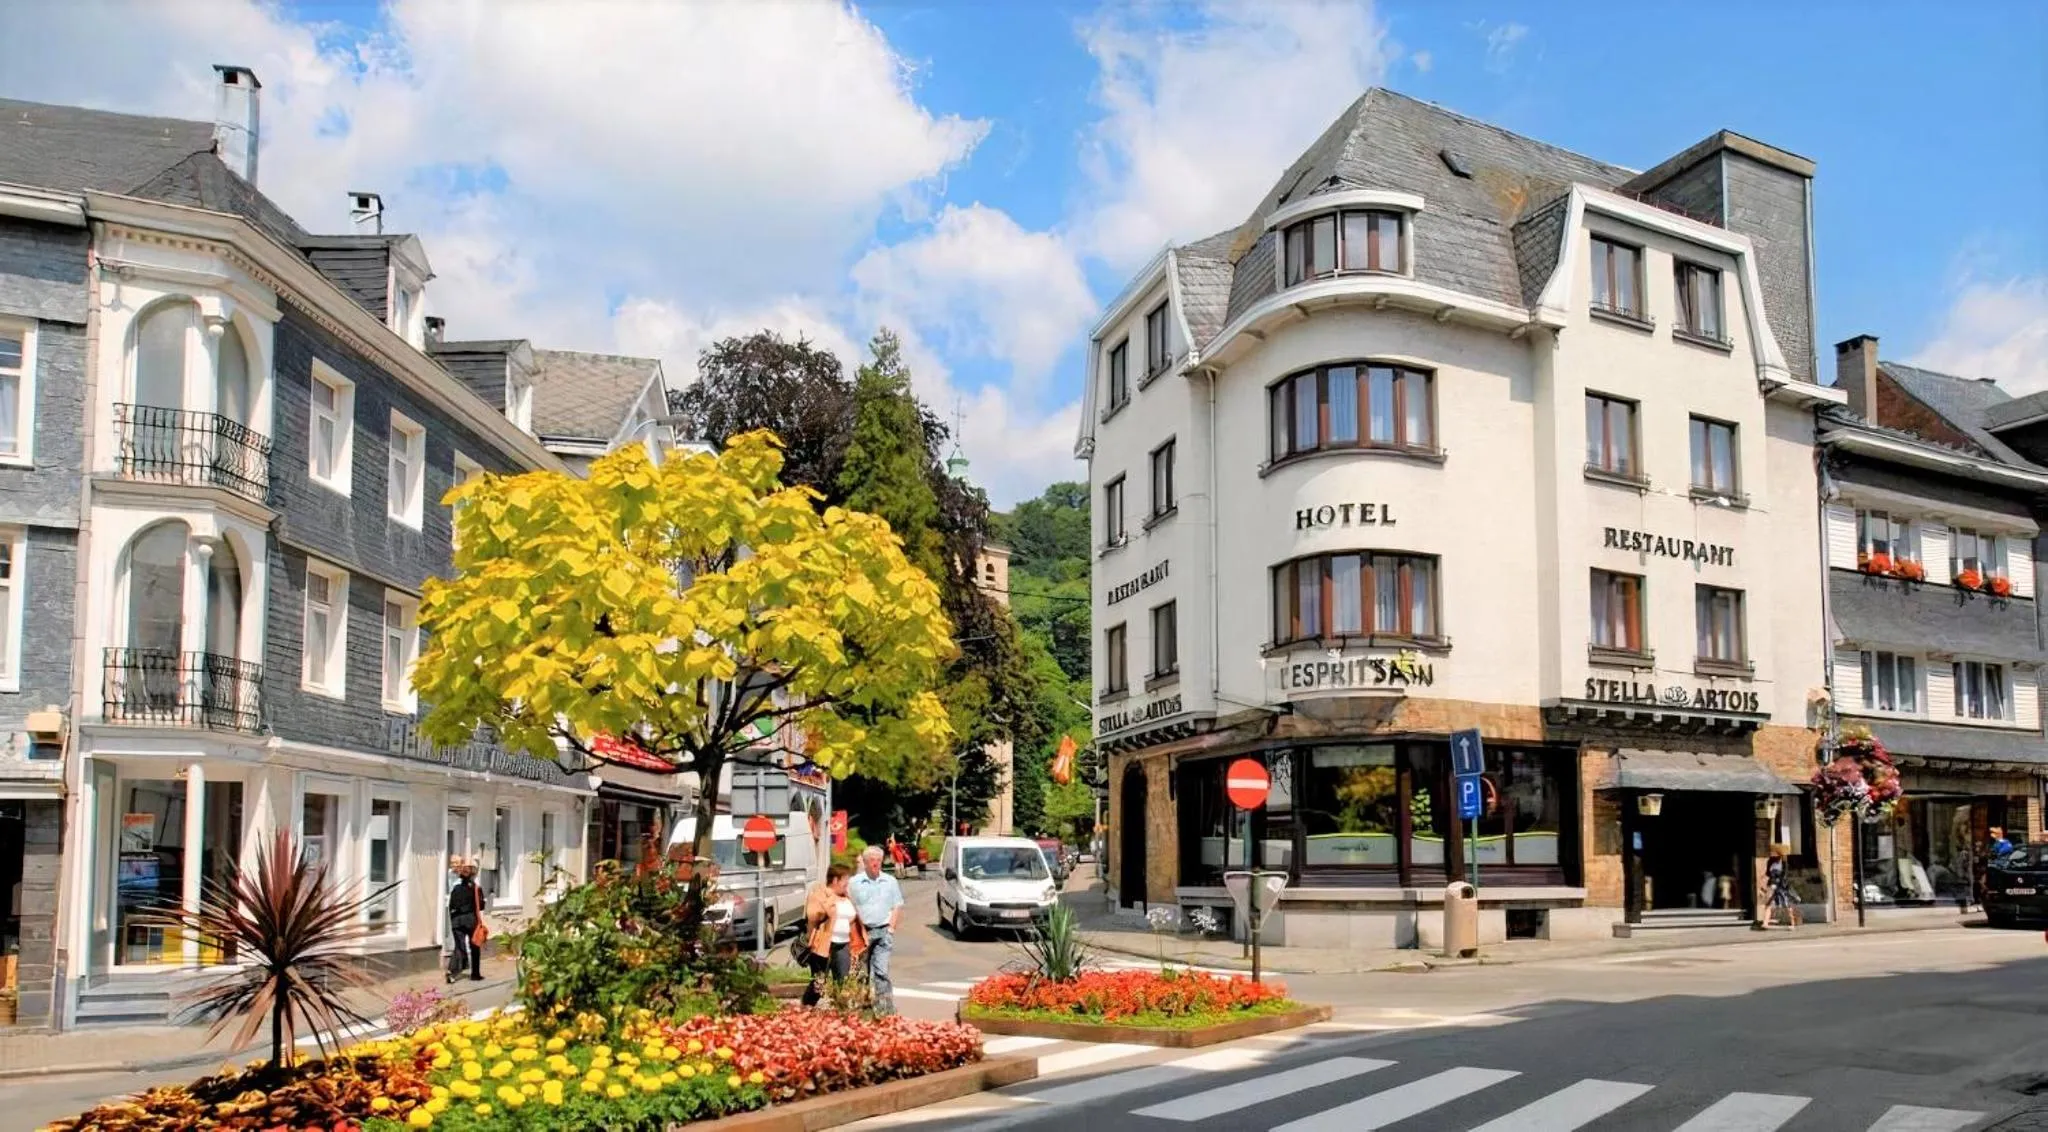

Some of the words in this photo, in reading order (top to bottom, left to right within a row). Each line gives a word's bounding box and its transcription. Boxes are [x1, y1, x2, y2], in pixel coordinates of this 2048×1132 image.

[1296, 503, 1397, 530] HOTEL
[1604, 526, 1735, 567] RESTAURANT
[1585, 677, 1657, 704] STELLA
[1693, 687, 1760, 712] ARTOIS
[1463, 781, 1474, 804] P
